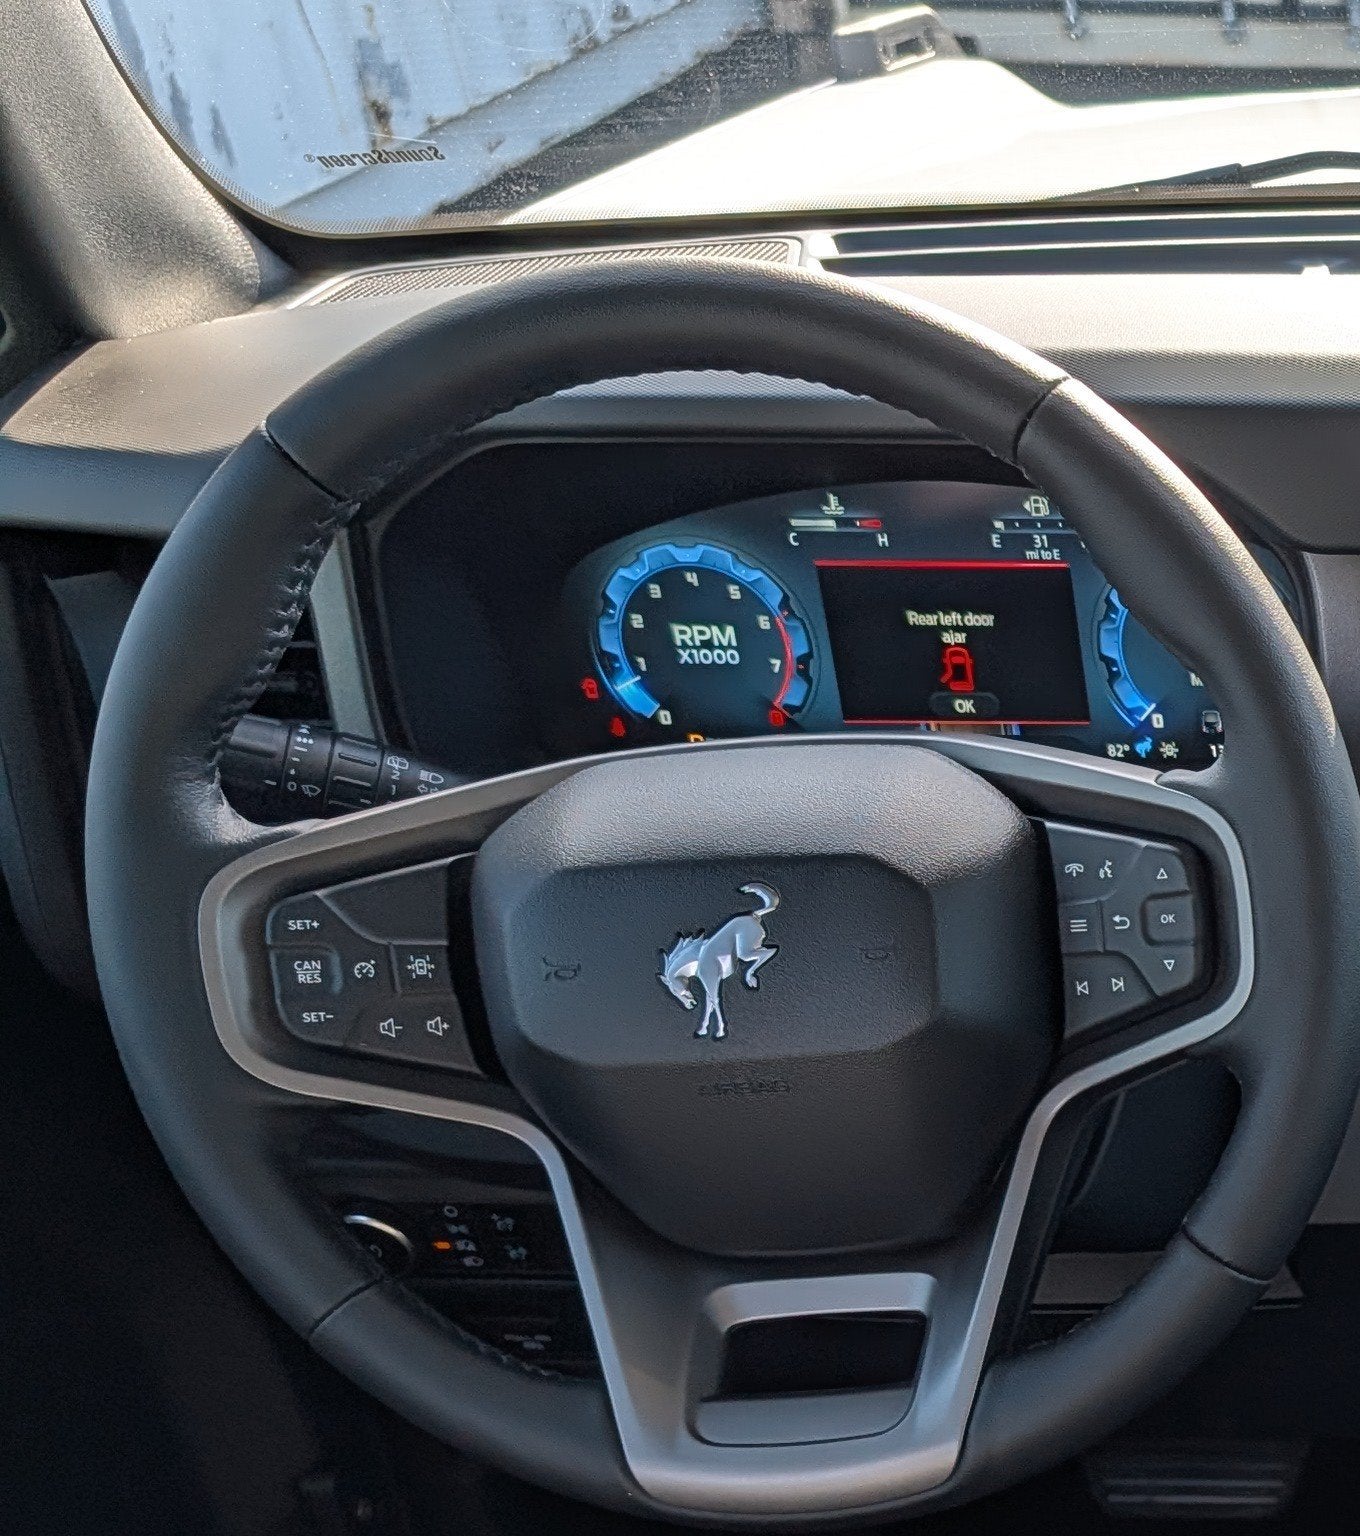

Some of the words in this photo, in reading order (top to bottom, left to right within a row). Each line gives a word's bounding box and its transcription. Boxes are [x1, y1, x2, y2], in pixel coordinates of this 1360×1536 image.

[789, 532, 799, 547] C
[878, 533, 889, 547] H
[992, 534, 1001, 548] E
[1033, 535, 1048, 548] 31
[1040, 549, 1050, 560] to
[684, 572, 699, 587] 4
[650, 584, 662, 599] 3
[728, 584, 741, 599] 5
[630, 614, 644, 629] 2
[758, 615, 771, 630] 6
[906, 611, 939, 626] Rear
[940, 610, 963, 626] left
[964, 611, 994, 626] door
[671, 624, 737, 647] RPM
[941, 631, 967, 645] ajar
[678, 649, 741, 665] X1000
[769, 658, 781, 673] 7
[954, 700, 976, 714] OK
[657, 710, 672, 725] 0
[288, 919, 320, 931] SET+
[1160, 913, 1176, 924] OK
[294, 960, 321, 971] CAN
[298, 974, 322, 984] RES
